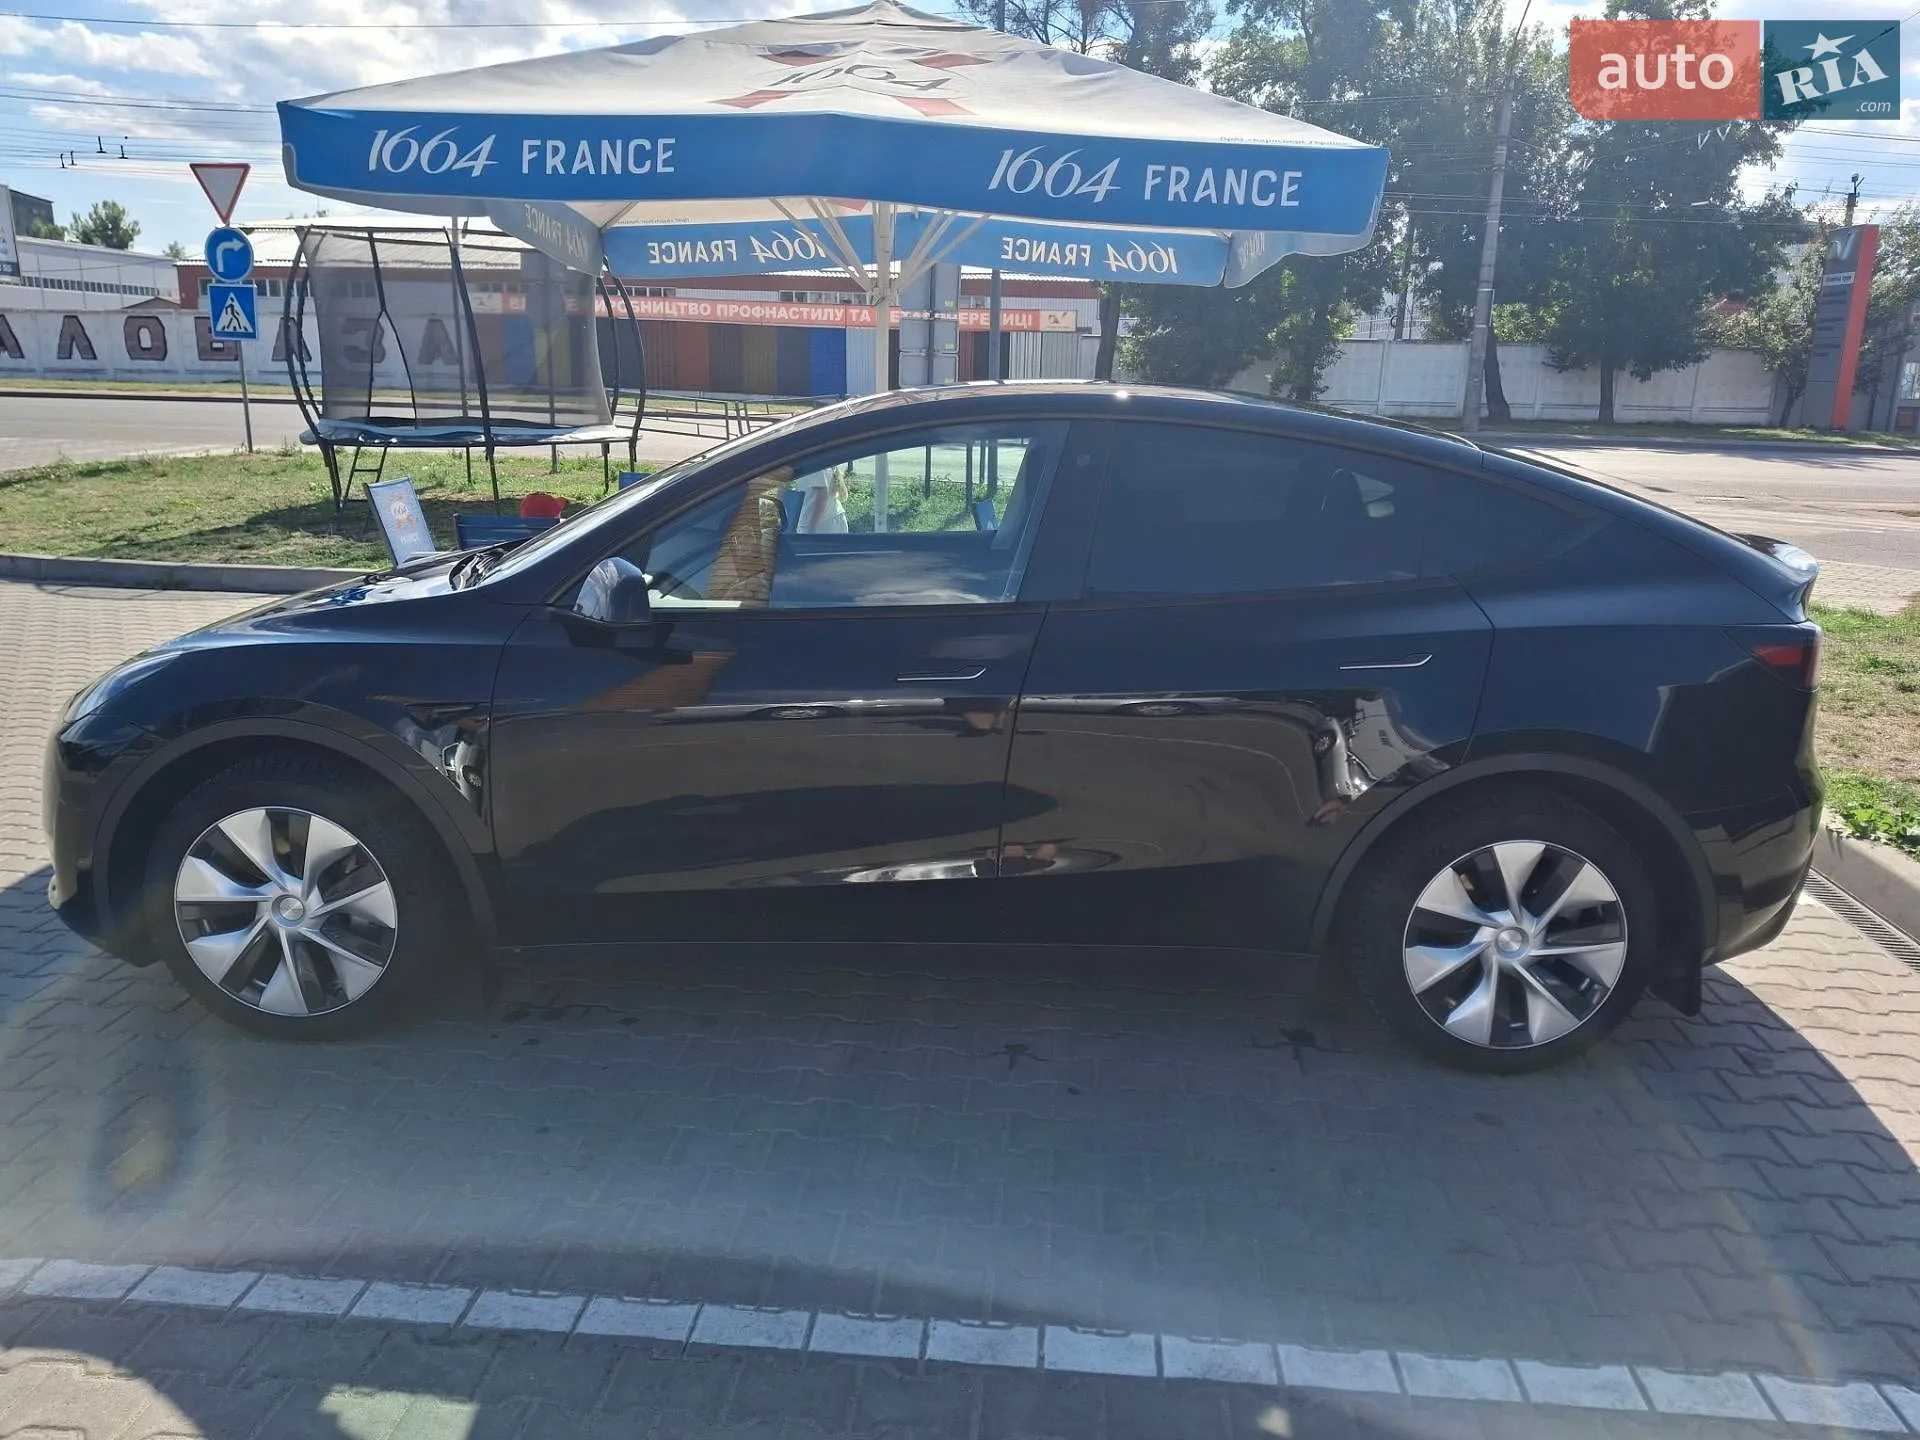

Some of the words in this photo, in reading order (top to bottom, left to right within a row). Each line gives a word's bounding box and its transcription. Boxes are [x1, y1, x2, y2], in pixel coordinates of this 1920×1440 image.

[369, 125, 498, 177] 1664
[521, 138, 676, 175] FRANCE
[988, 144, 1121, 203] 1664
[1144, 164, 1303, 206] FRANCE
[594, 299, 711, 317] ИРОБНИЦТВО
[716, 304, 845, 322] ПРОФНАСТИЛУ
[850, 309, 871, 322] ТА
